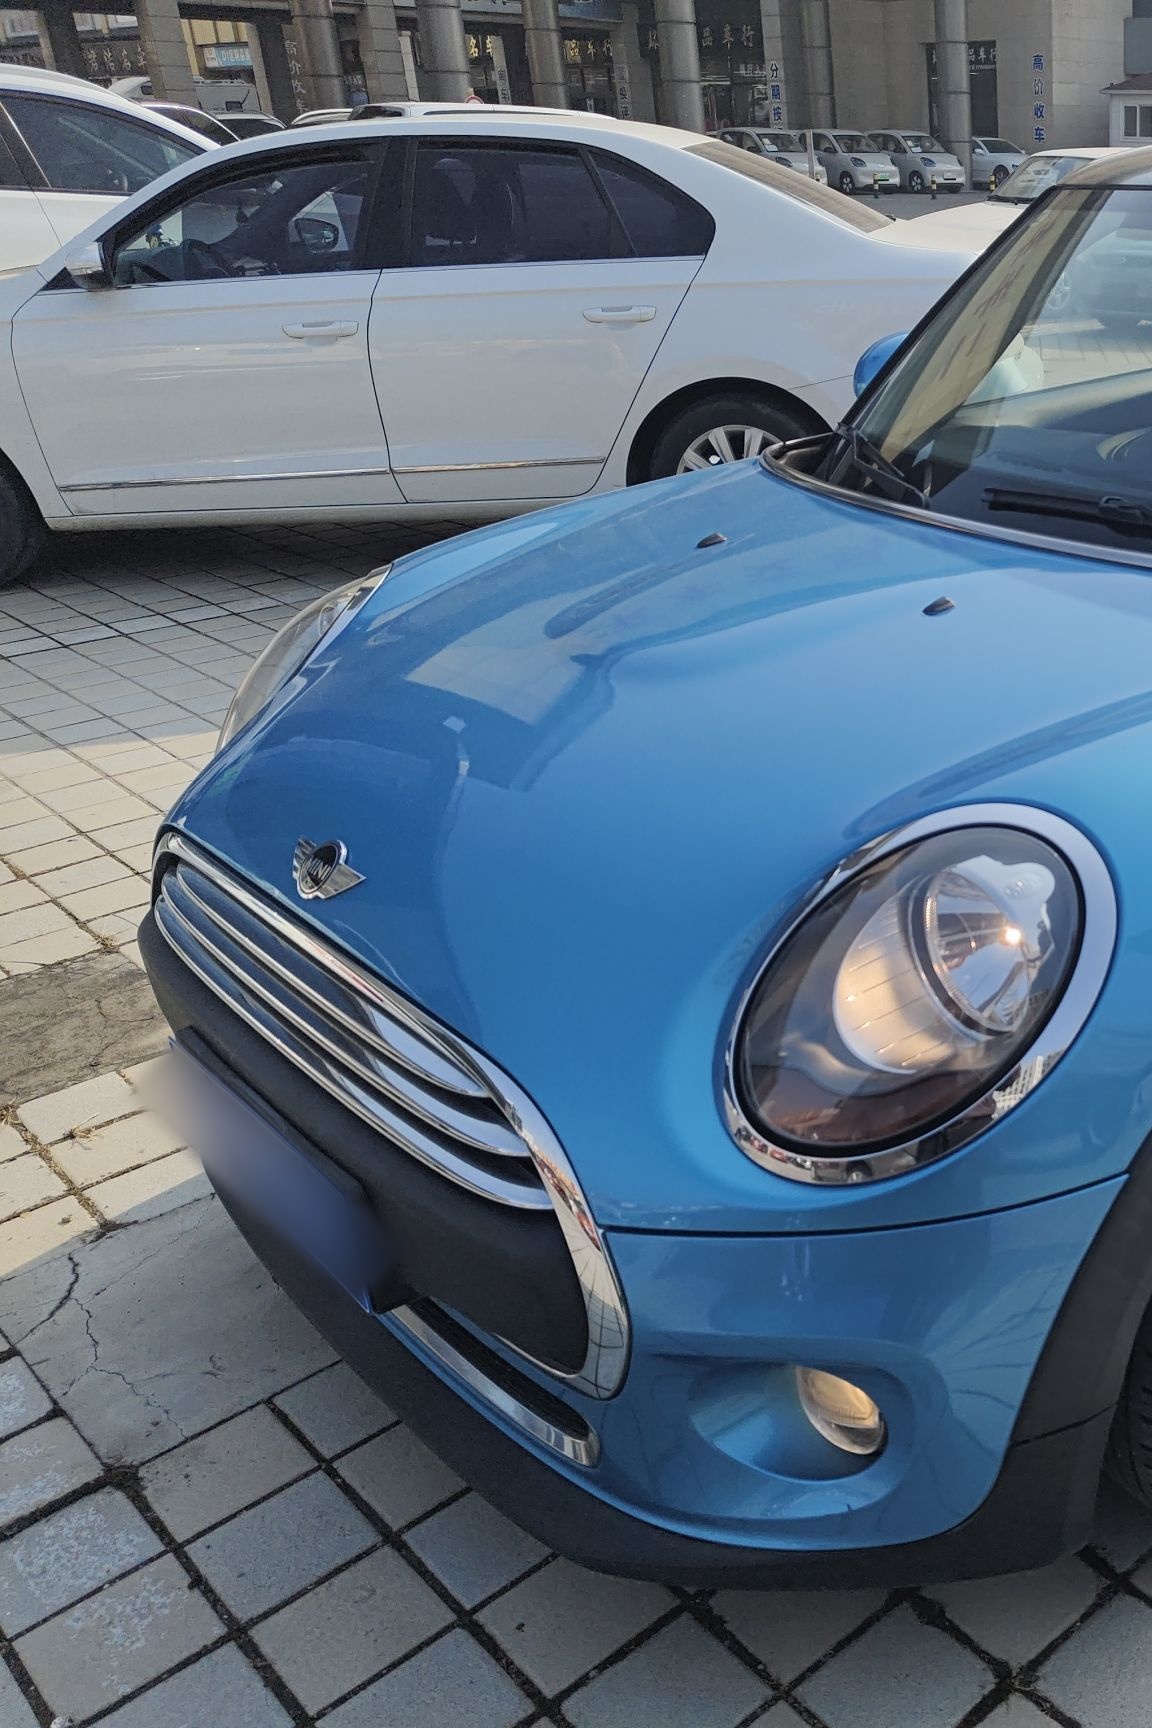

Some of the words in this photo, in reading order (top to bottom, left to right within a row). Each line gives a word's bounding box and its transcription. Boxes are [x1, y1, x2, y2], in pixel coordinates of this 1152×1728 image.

[769, 60, 784, 129] 分期按
[1033, 54, 1046, 143] 高价收车
[303, 854, 332, 881] MINI
